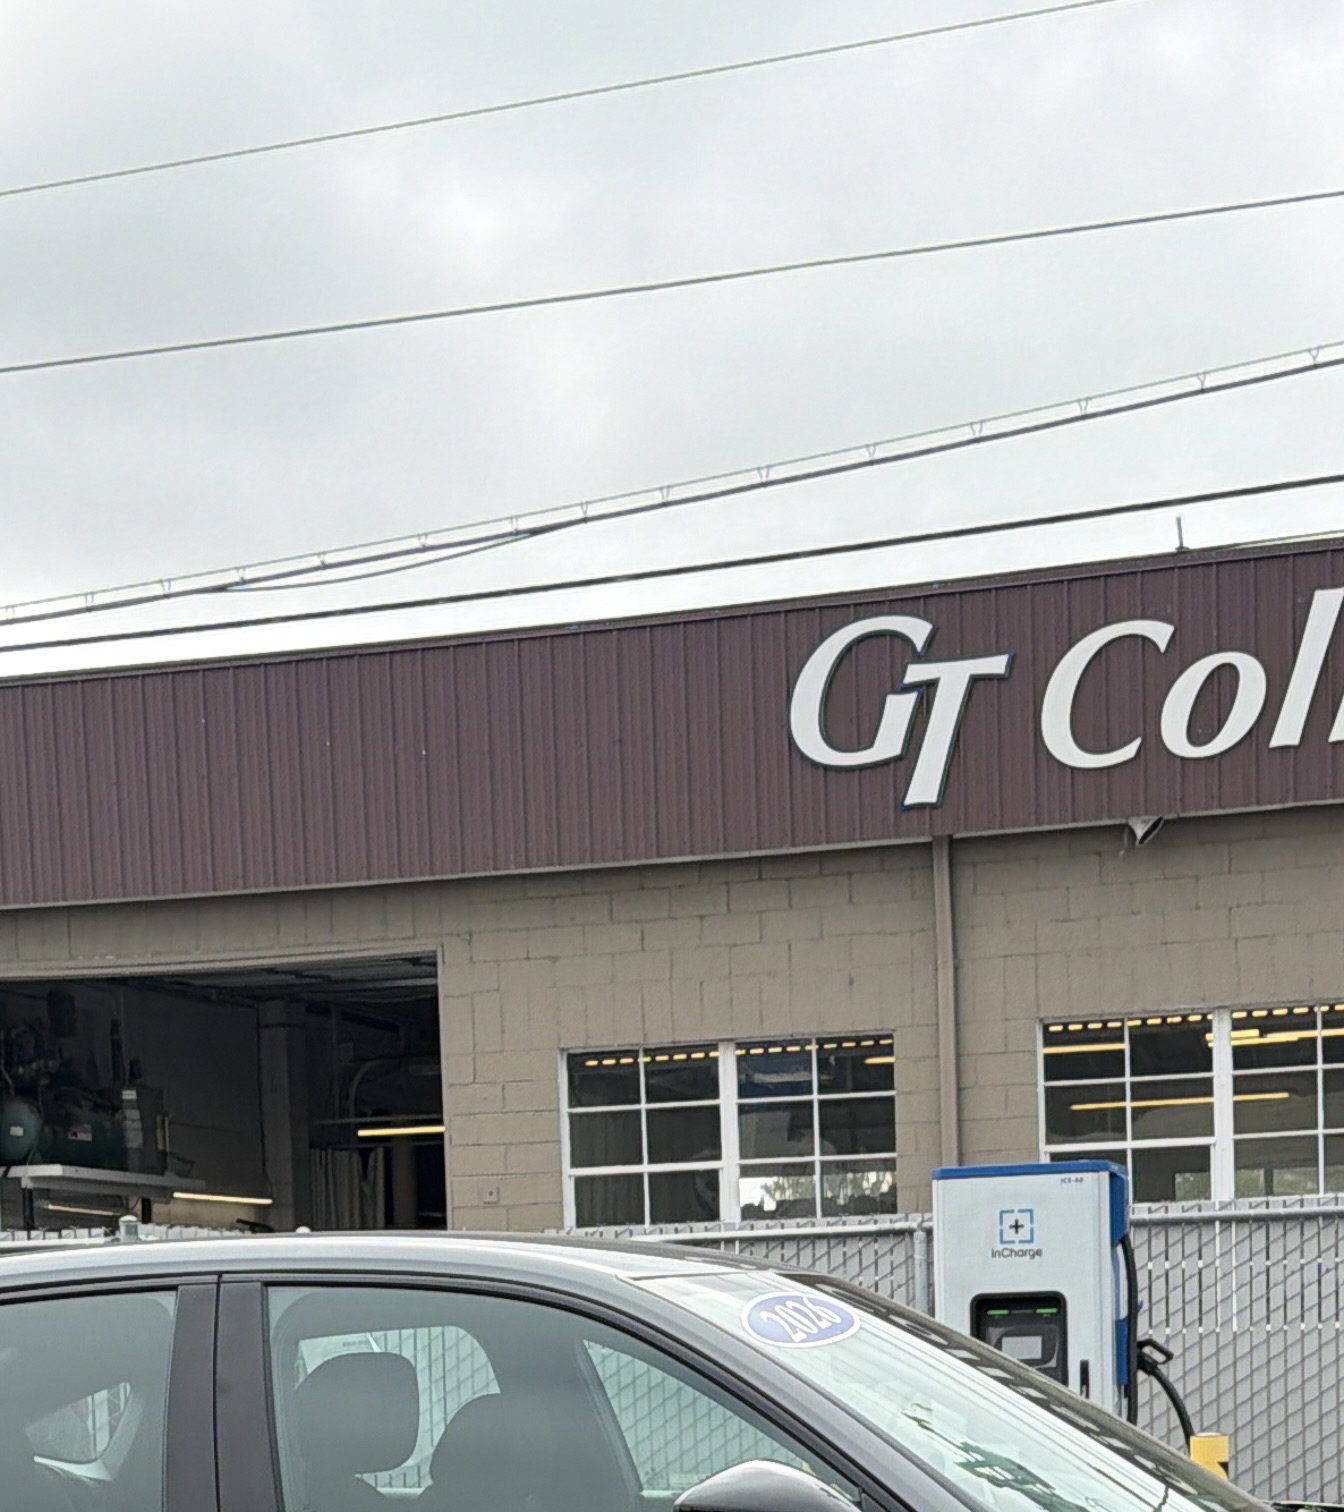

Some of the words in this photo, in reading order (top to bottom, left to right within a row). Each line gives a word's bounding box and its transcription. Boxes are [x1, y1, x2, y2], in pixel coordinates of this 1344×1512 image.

[787, 613, 1013, 811] GT
[991, 1247, 1043, 1261] InCharge
[759, 1296, 843, 1343] 2026
